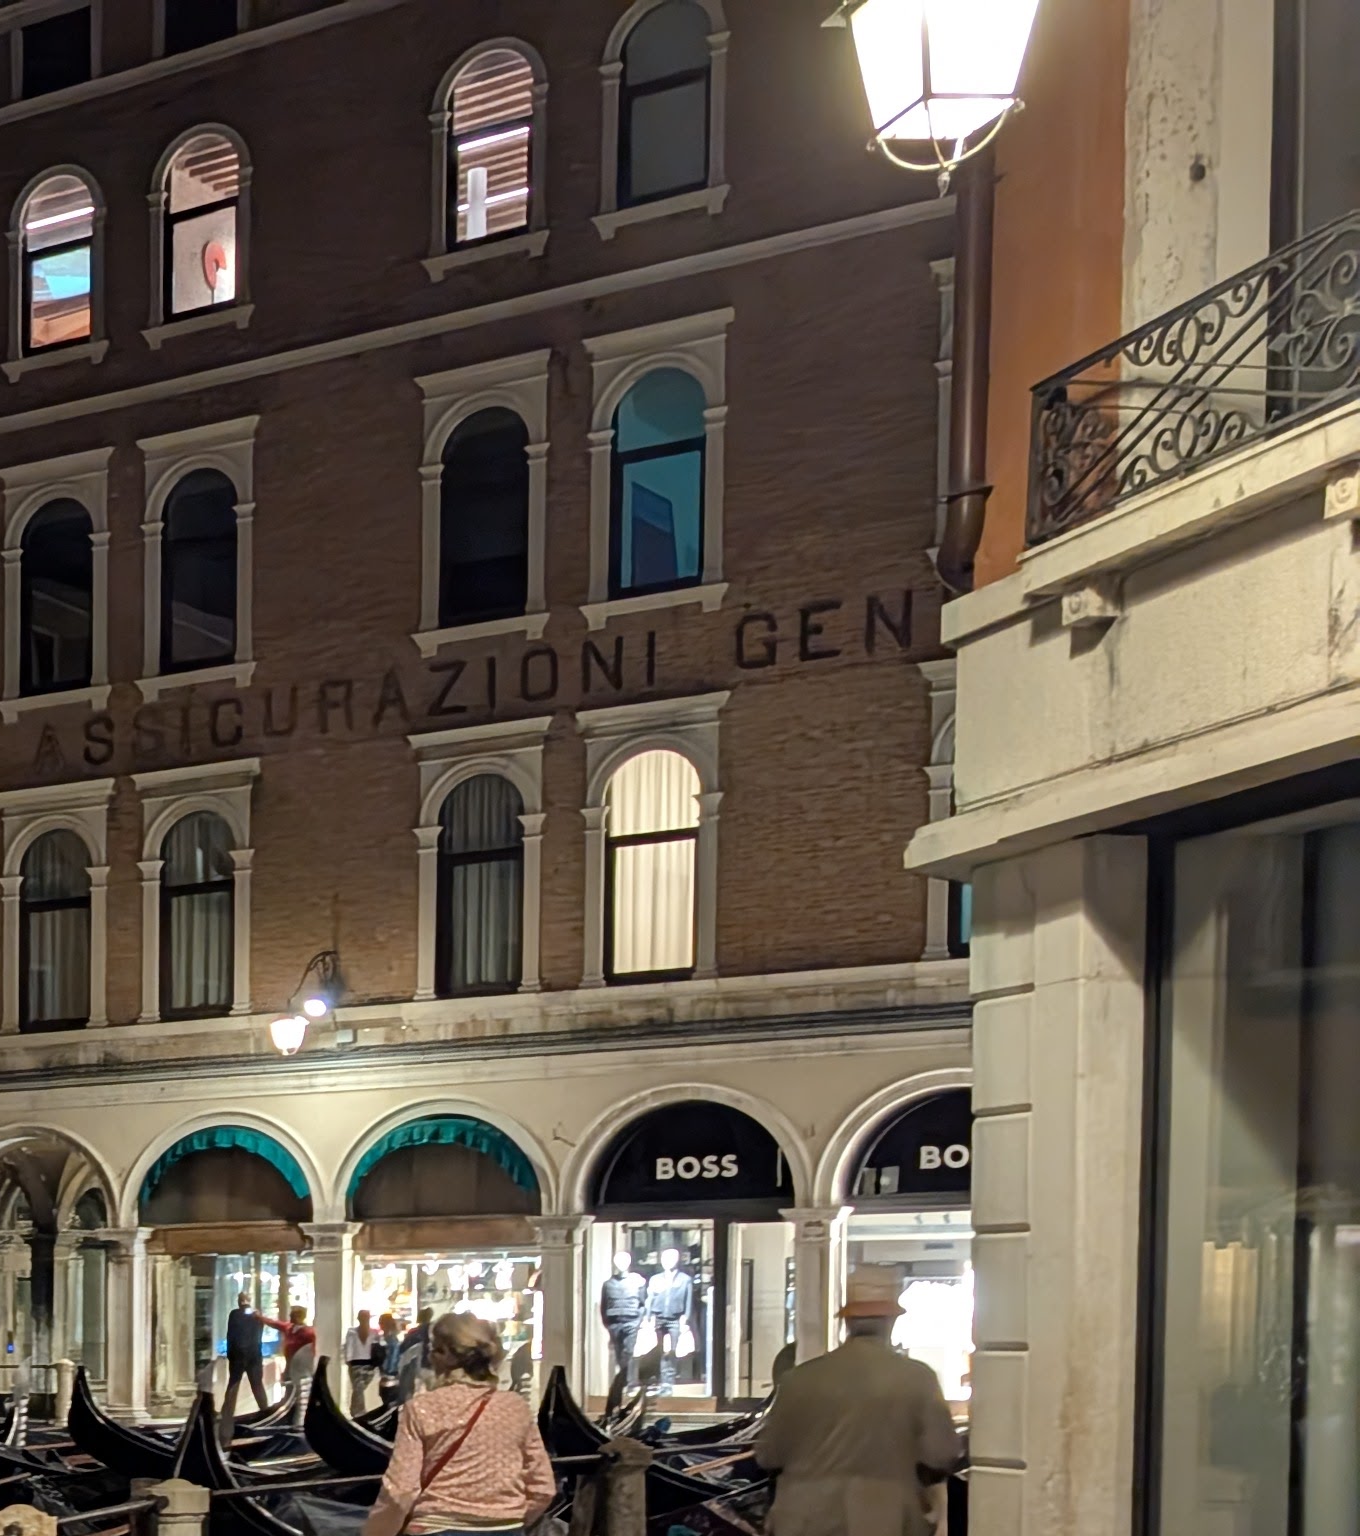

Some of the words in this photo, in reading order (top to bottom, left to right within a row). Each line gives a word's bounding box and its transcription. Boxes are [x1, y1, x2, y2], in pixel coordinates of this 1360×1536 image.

[33, 630, 656, 774] ASSICURAZIONI
[735, 588, 912, 670] GEN
[655, 1153, 739, 1181] BOSS
[919, 1143, 970, 1170] BO
